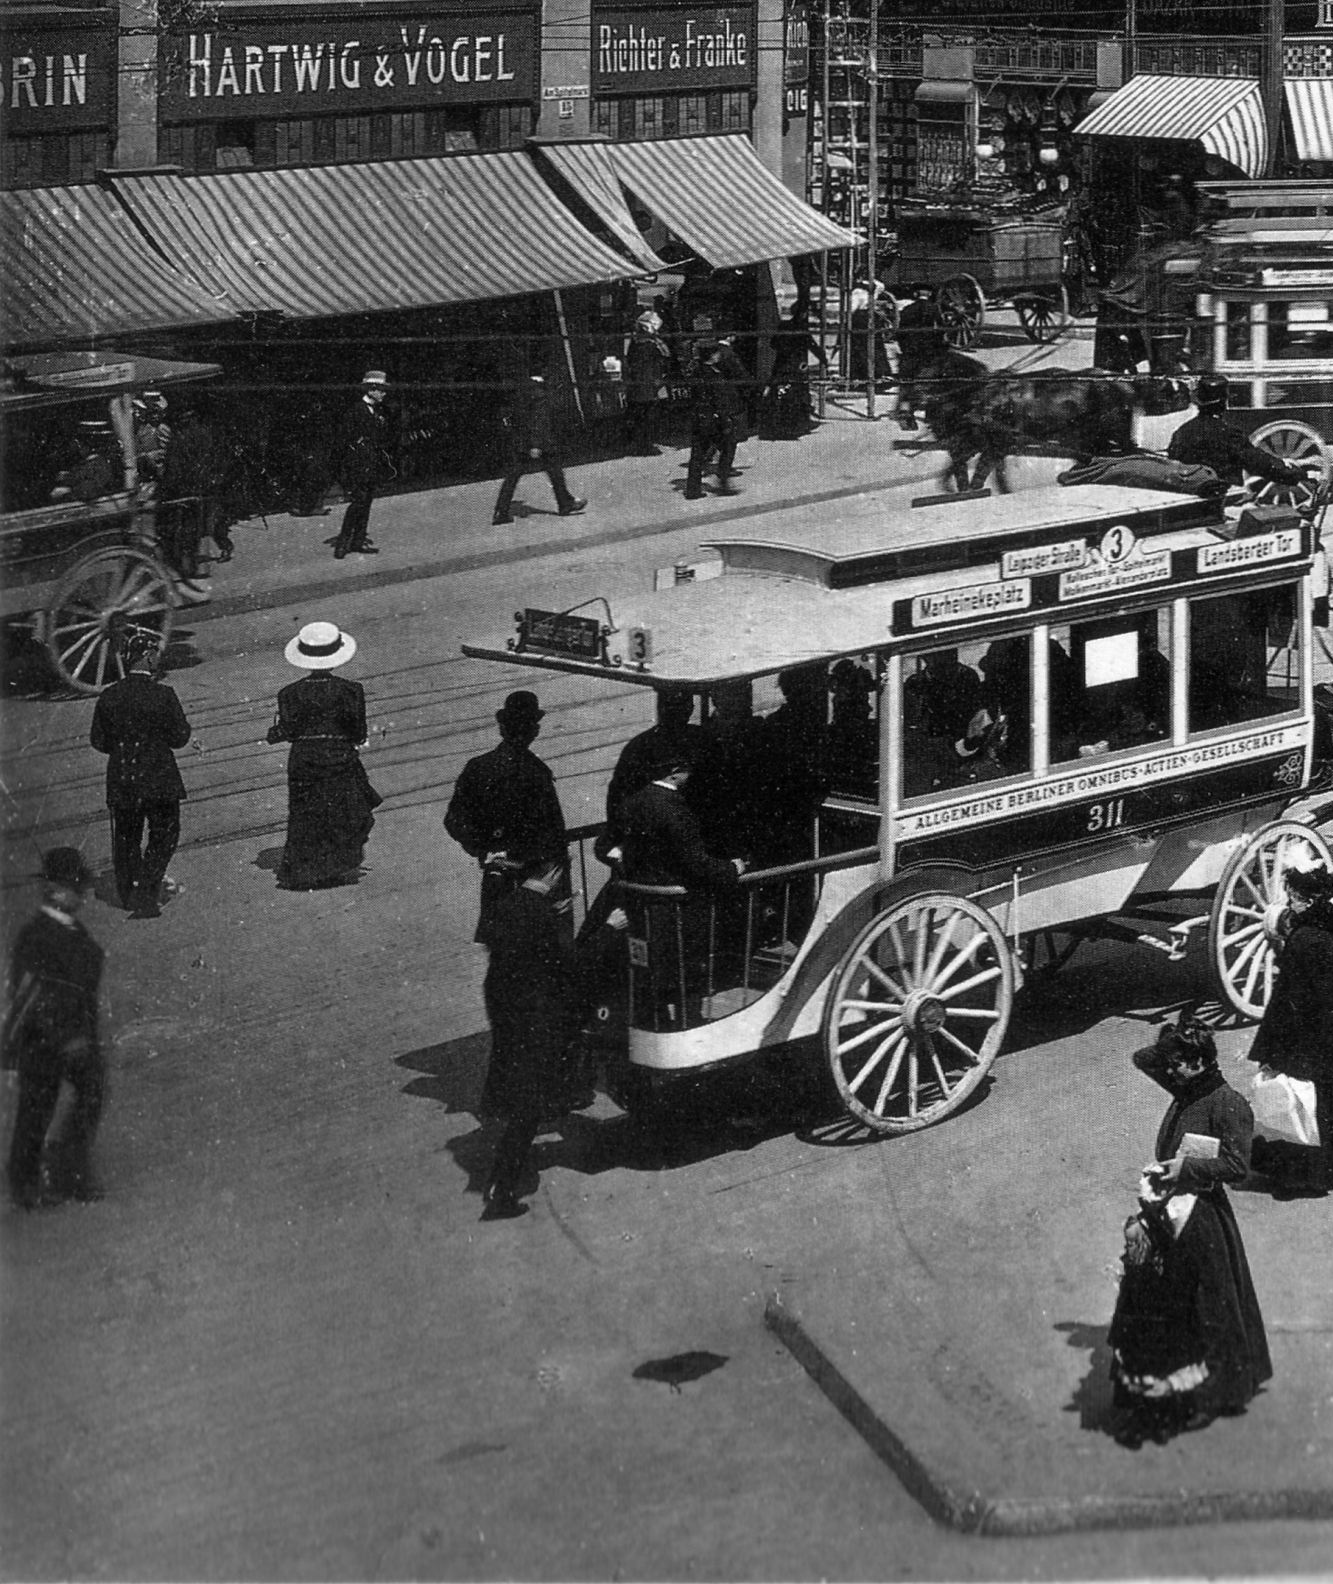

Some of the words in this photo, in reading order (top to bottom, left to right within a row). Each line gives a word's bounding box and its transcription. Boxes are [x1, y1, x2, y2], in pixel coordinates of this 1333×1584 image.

[188, 31, 362, 98] HARTWIG
[374, 54, 396, 89] &
[600, 24, 666, 73] Richter
[669, 43, 681, 69] &
[0, 54, 87, 108] RIN
[1110, 528, 1123, 560] 3
[1203, 539, 1273, 567] Landsberger
[1275, 535, 1294, 554] Tor
[1006, 550, 1052, 575] Leipziger
[919, 585, 1024, 619] Marheinekeplatz
[633, 631, 646, 659] 3
[914, 797, 1004, 830] ALLGEMEINE
[1007, 782, 1076, 810] BERLINER
[1087, 800, 1125, 832] 311
